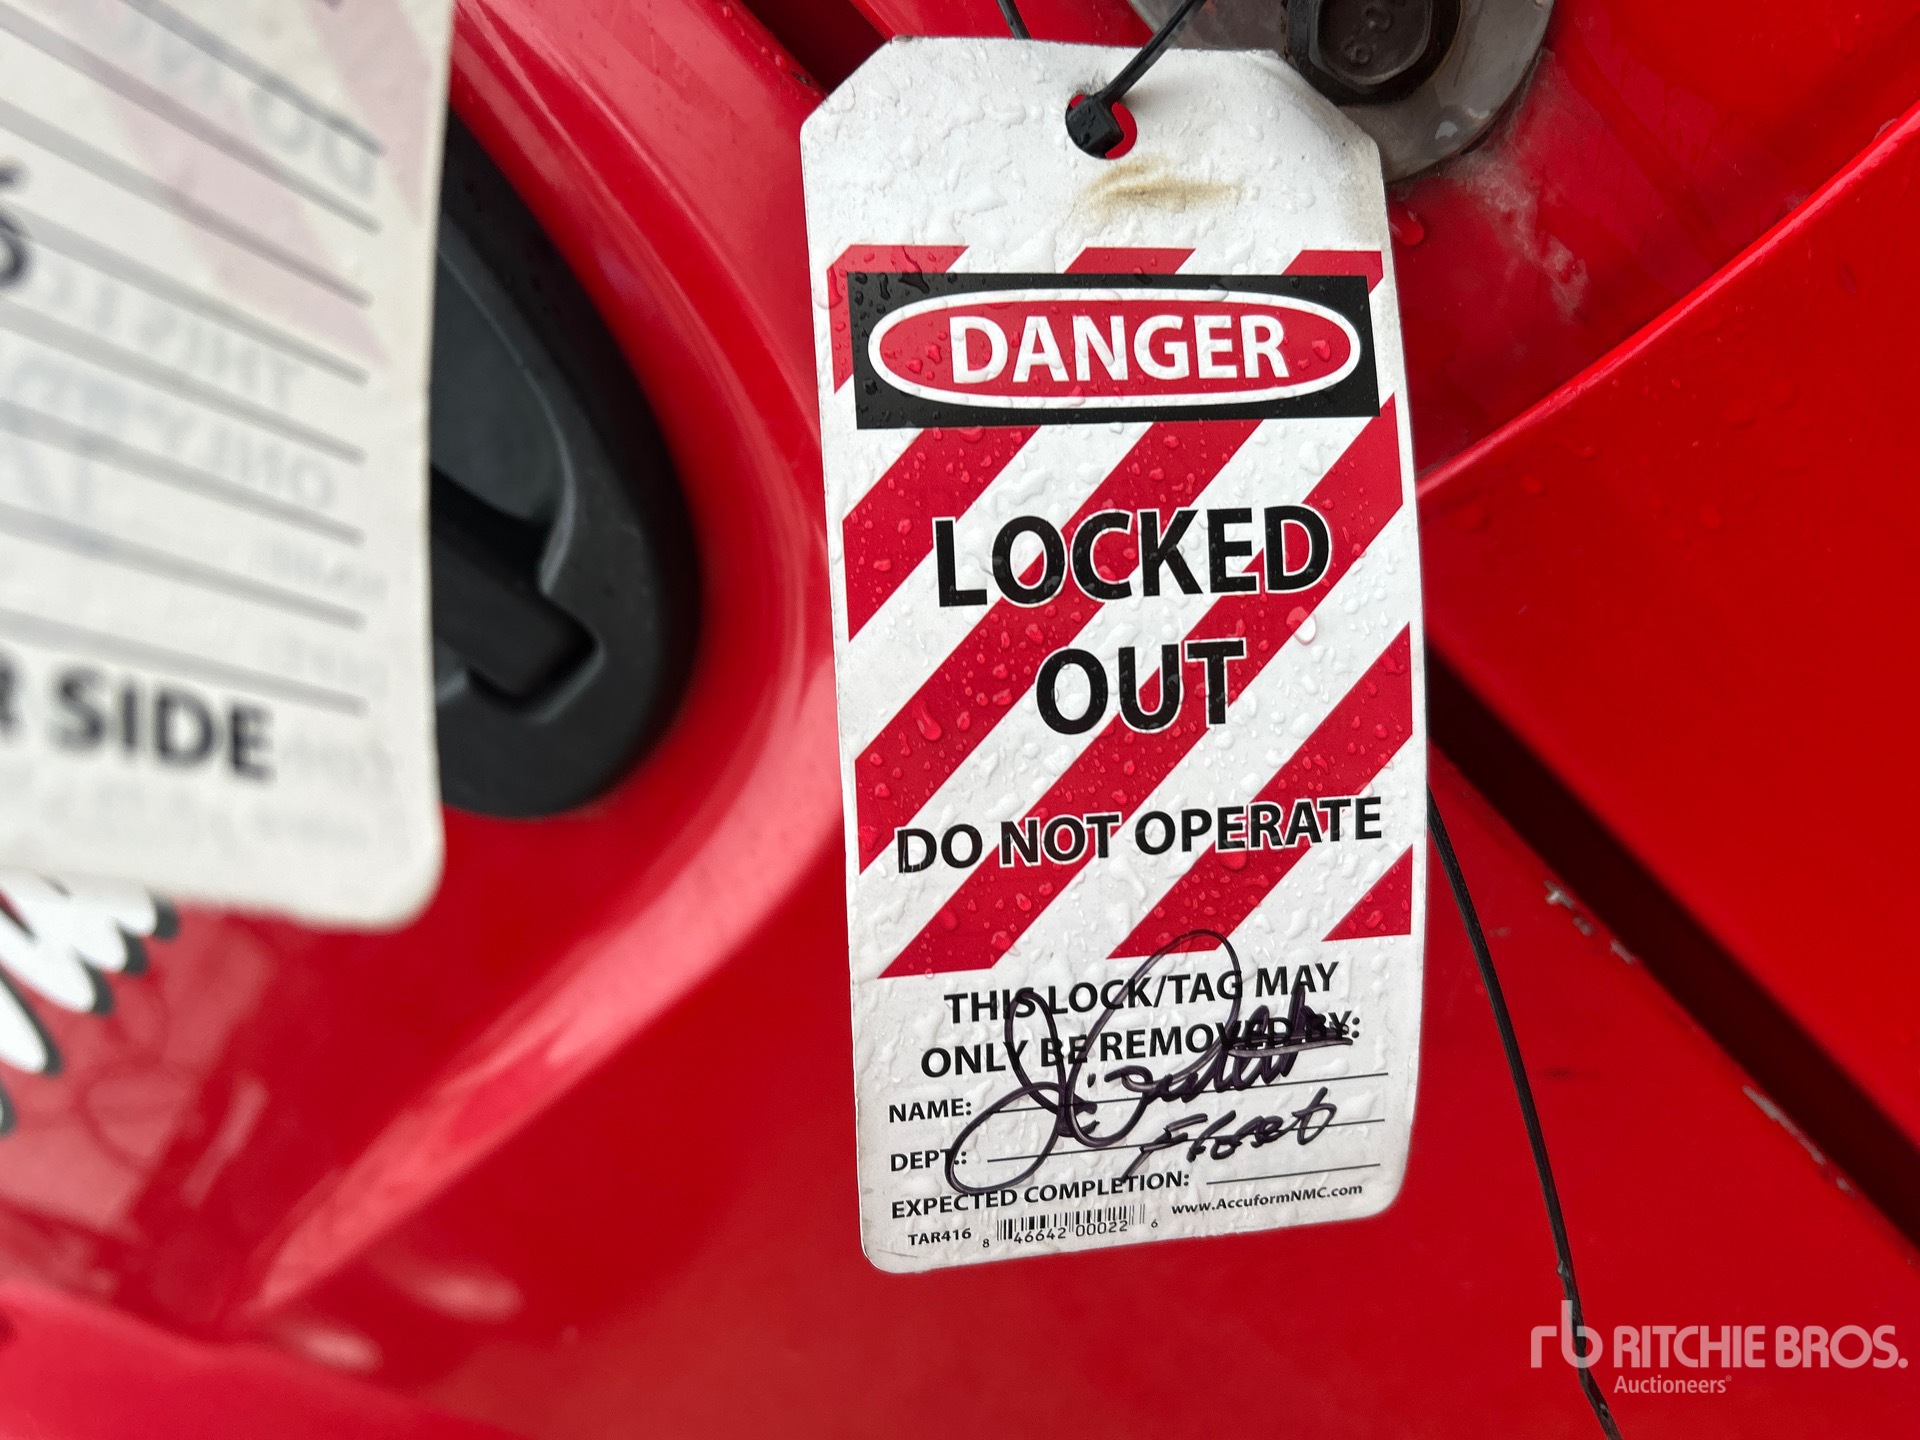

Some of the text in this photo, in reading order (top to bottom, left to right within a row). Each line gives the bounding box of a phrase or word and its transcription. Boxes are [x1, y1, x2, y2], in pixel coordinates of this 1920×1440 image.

[949, 314, 1290, 384] DANGER
[932, 505, 1330, 607] LOCKED
[1036, 638, 1245, 735] OUT
[53, 664, 275, 782] SIDE
[897, 797, 1382, 873] DO NOT OPERATE
[944, 961, 1339, 1024] THIS LOCK/TAG MAY
[921, 1010, 1360, 1078] ONLY BE REMOVED BY:
[889, 1098, 972, 1123] NAME:
[892, 1171, 1190, 1219] EXPECTED COMPLETION:
[1171, 1184, 1363, 1214] www.AccuformNMC.com
[908, 1220, 1159, 1248] TAR416 8 46642 00022 6
